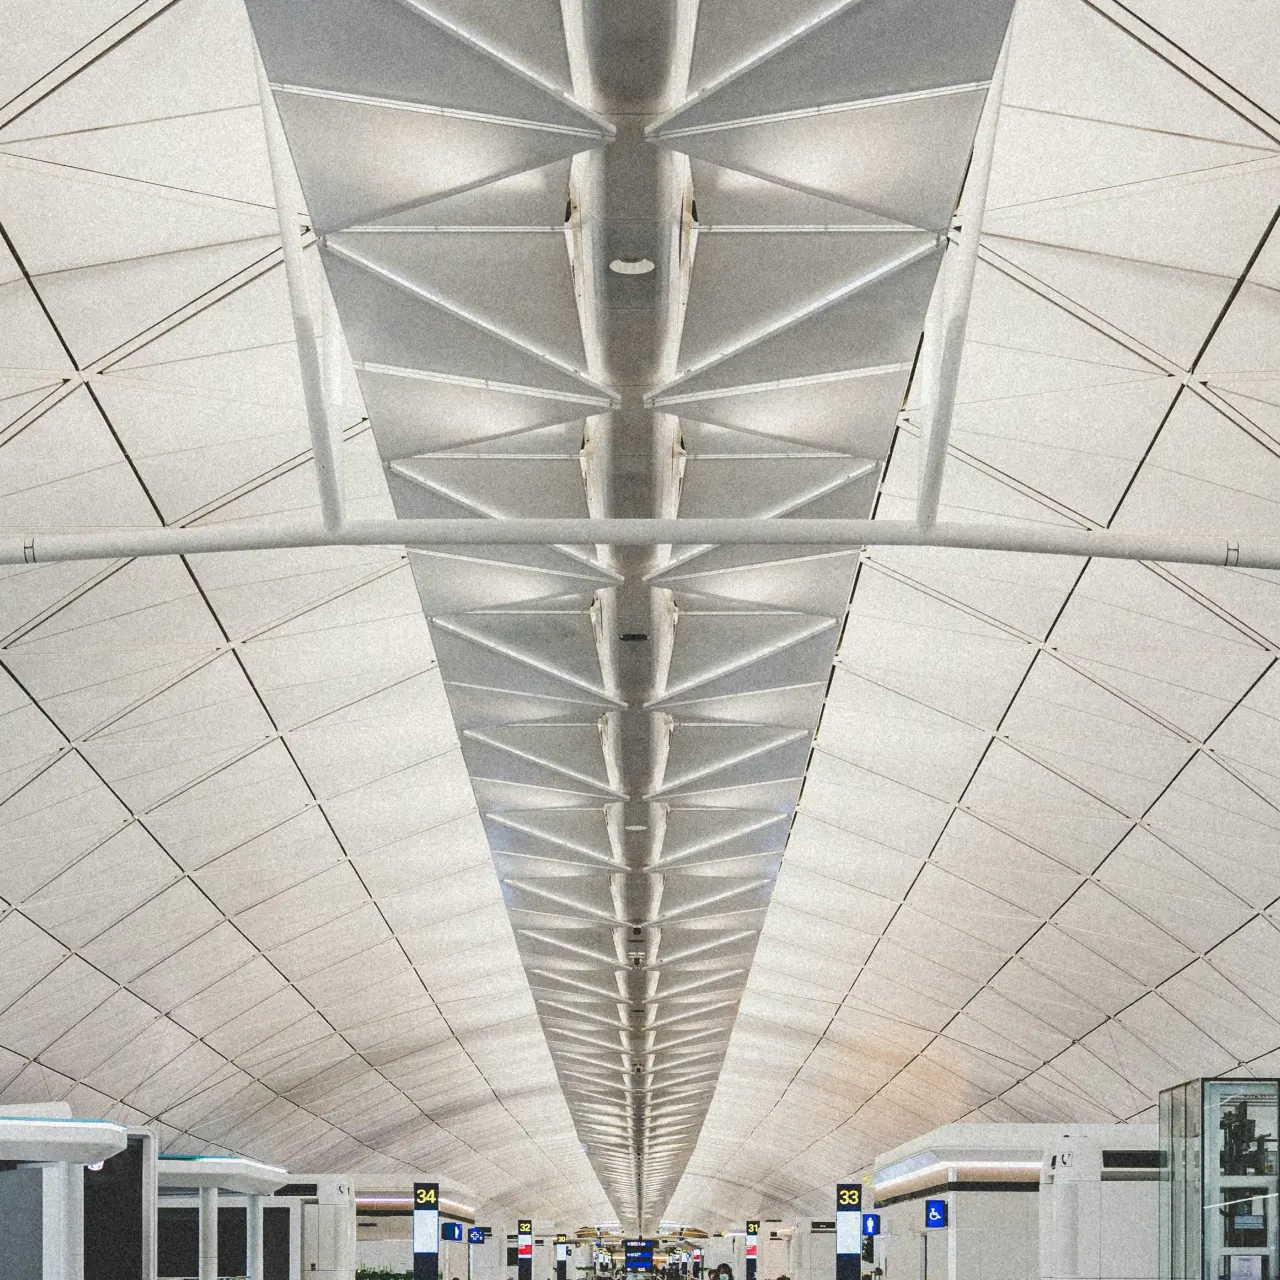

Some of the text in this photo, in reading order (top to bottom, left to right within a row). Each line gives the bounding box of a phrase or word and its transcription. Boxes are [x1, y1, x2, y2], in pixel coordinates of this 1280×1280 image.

[416, 1189, 436, 1204] 34
[839, 1190, 859, 1204] 33
[520, 1223, 531, 1232] 32
[748, 1223, 758, 1232] 31
